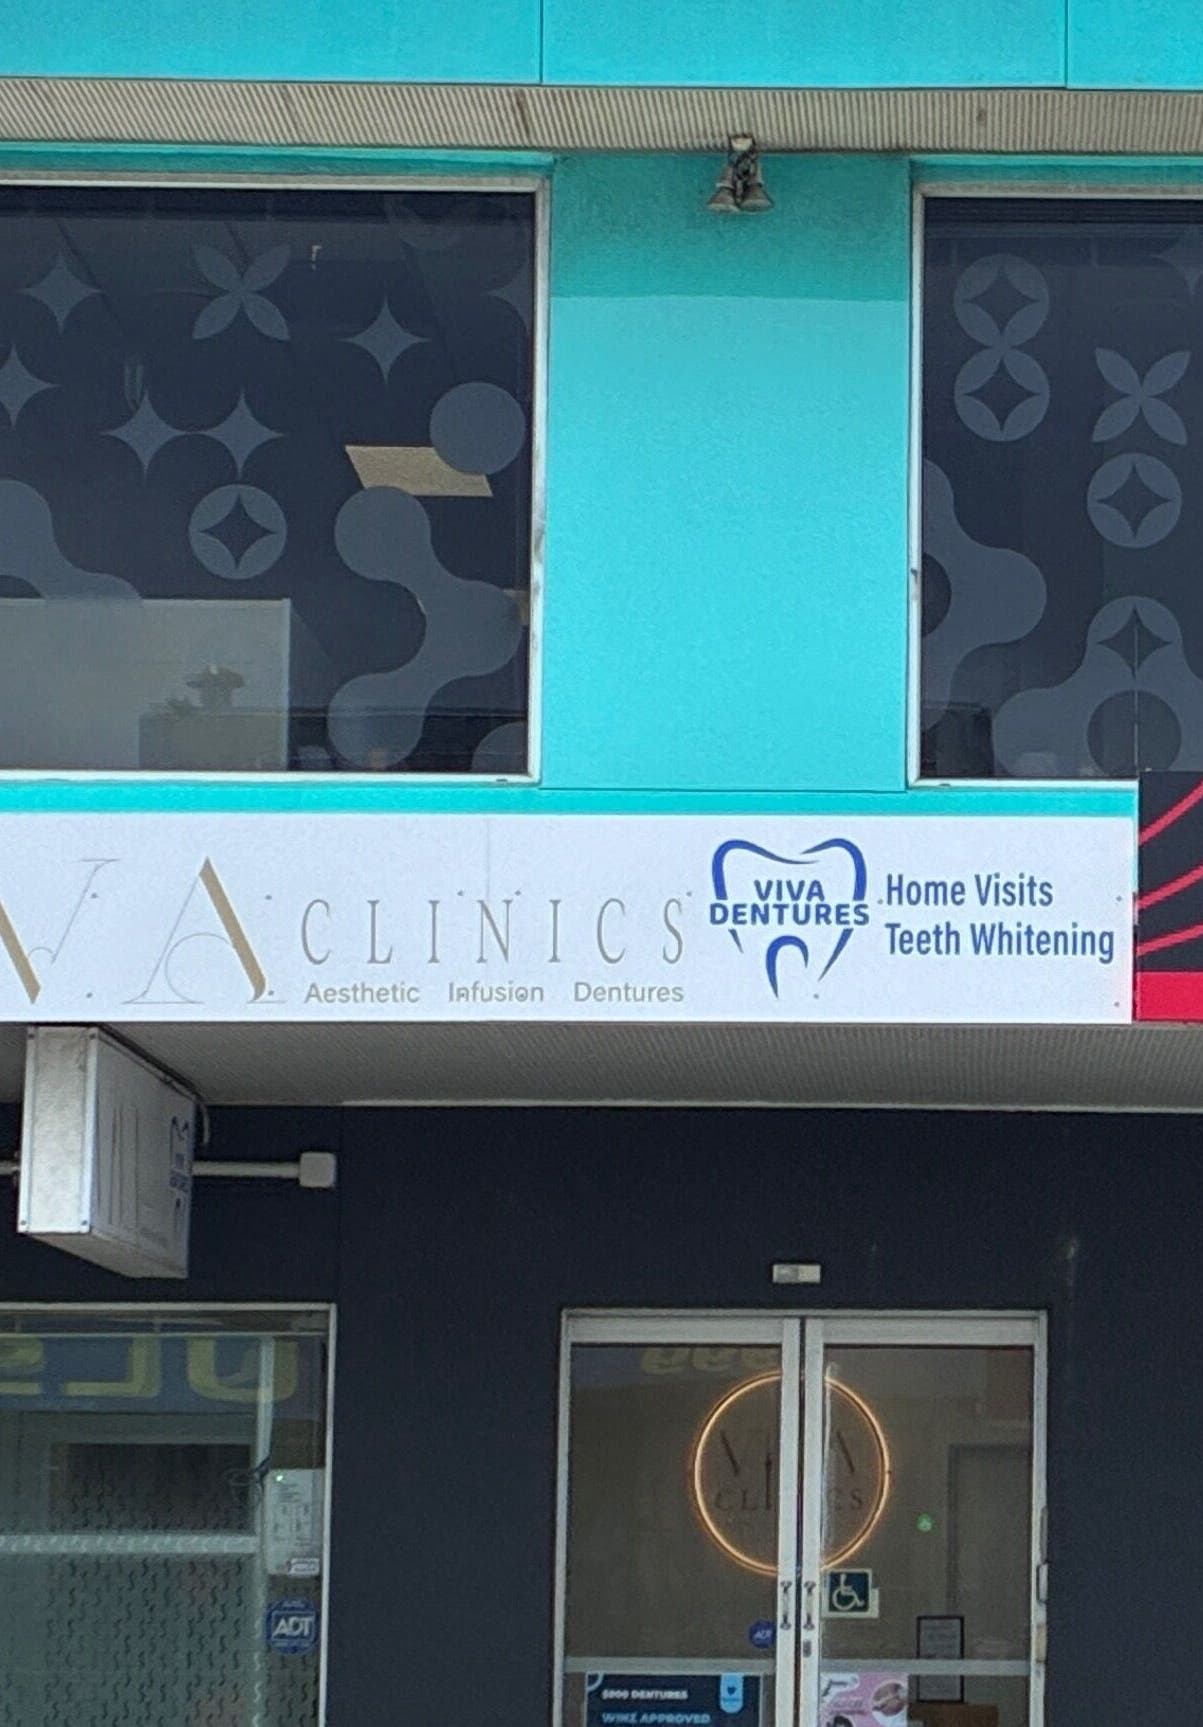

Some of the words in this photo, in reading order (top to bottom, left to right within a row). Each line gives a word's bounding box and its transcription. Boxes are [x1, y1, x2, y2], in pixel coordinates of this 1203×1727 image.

[753, 879, 826, 902] VIVA
[886, 873, 964, 907] Home
[974, 872, 1054, 907] Visits
[709, 902, 870, 927] DENTURES
[301, 897, 684, 965] CLINICS
[884, 922, 962, 957] Teeth
[970, 922, 1115, 964] Whitening
[304, 980, 420, 1003] Aesthetic
[448, 980, 545, 1003] Infusion
[573, 981, 685, 1003] Dentures
[271, 1616, 313, 1638] ADT
[641, 1712, 710, 1725] APPROVED
